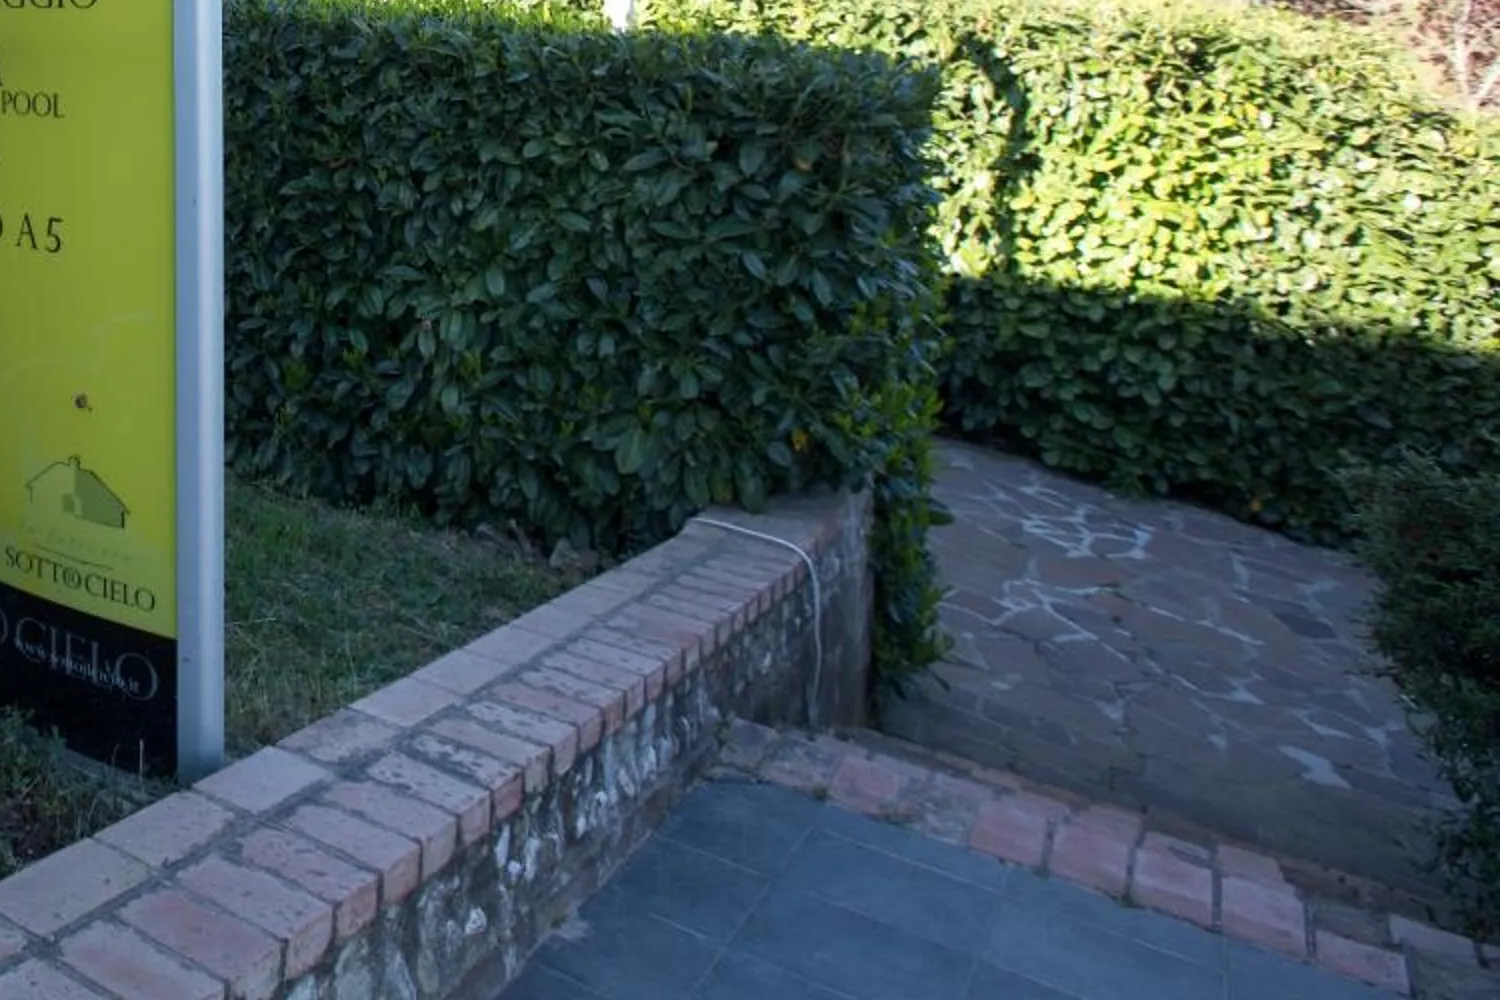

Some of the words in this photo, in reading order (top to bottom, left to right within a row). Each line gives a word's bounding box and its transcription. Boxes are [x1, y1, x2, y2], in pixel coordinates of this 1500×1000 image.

[2, 90, 65, 118] POOL
[16, 212, 38, 251] A
[45, 217, 64, 253] 5
